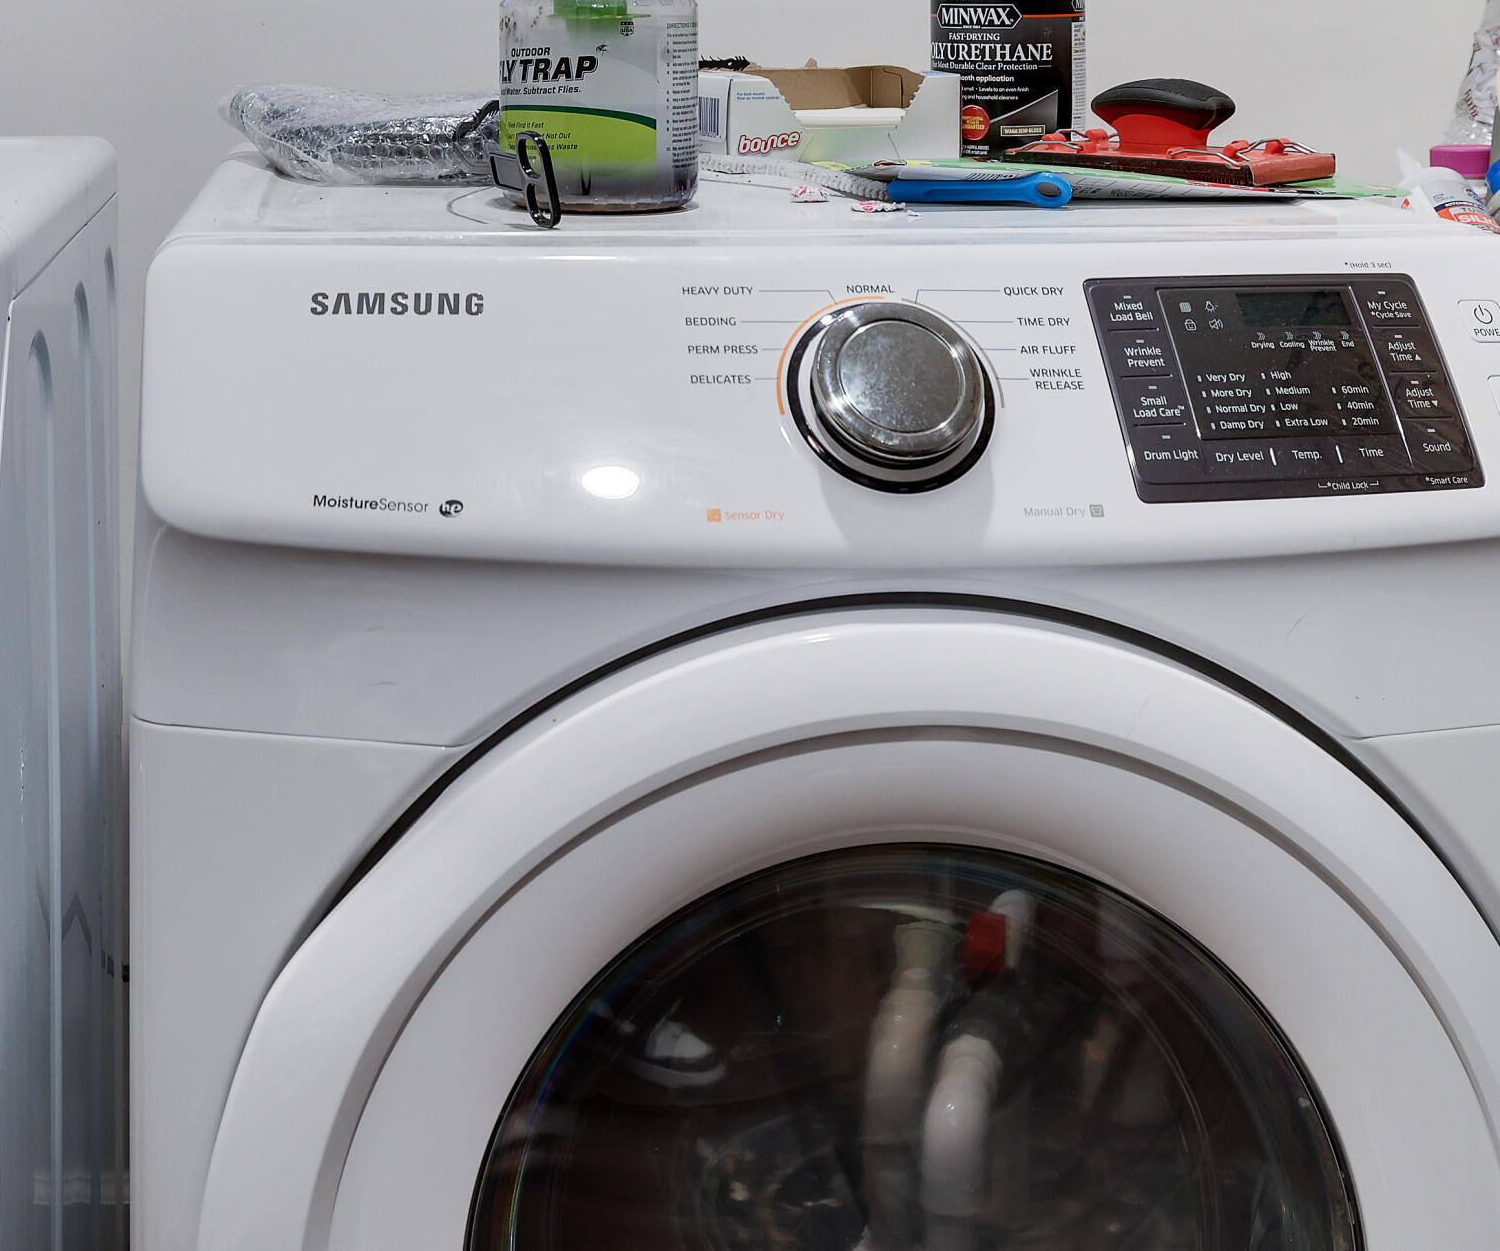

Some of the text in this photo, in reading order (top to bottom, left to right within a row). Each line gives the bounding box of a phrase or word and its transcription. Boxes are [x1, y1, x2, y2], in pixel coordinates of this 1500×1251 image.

[942, 7, 1011, 25] MINWAX
[948, 32, 1000, 41] FAST-DRYING
[511, 47, 550, 57] OUTDOOR
[519, 55, 599, 84] TRAP
[950, 61, 1037, 70] Durable Clear Protection
[976, 75, 1014, 83] application
[523, 87, 556, 95] Subtract
[738, 131, 800, 155] bounce
[682, 286, 754, 295] HEAVY DUTY
[846, 284, 895, 294] NORMAL
[1003, 286, 1064, 296] QUICK DRY
[310, 292, 485, 316] SAMSUNG
[1114, 302, 1143, 311] Mixed
[1368, 301, 1407, 310] My Cycle
[1110, 312, 1153, 321] Load Bell
[685, 317, 737, 326] BEDDING
[1016, 317, 1070, 326] TIME DRY
[688, 345, 758, 354] PERM PRESS
[1020, 345, 1076, 354] AIR FLUFF
[1388, 341, 1416, 351] Adjust
[1124, 347, 1162, 356] Wrinkle
[1390, 353, 1413, 361] Time
[1127, 358, 1165, 367] Prevent
[1030, 369, 1082, 378] WRINKLE
[1206, 373, 1245, 383] Very Dry
[1270, 371, 1292, 381] High
[690, 374, 751, 384] DELICATES
[1035, 381, 1085, 390] RELEASE
[1341, 385, 1369, 394] 60min
[1211, 389, 1252, 398] More Dry
[1275, 386, 1311, 395] Medium
[1406, 388, 1434, 397] Adjust
[1140, 396, 1167, 405] Small
[1408, 399, 1431, 408] Time
[1215, 404, 1266, 413] Normal Dry
[1280, 402, 1298, 410] Low
[1347, 401, 1374, 410] 40min
[1133, 409, 1157, 418] Load
[1220, 420, 1264, 430] Damp Dry
[1285, 417, 1328, 426] Extra Low
[1351, 416, 1380, 426] 20min
[1423, 442, 1451, 452] Sound
[1144, 449, 1199, 460] Drum Light
[1215, 451, 1264, 463] Dry Level
[1292, 450, 1323, 460] Temp.
[1359, 448, 1385, 457] Time
[1452, 476, 1468, 484] Care
[1351, 481, 1369, 490] Lock
[313, 494, 429, 513] MoistureSensor
[725, 510, 785, 523] Sensor Dry
[1023, 506, 1086, 519] Manual Dry
